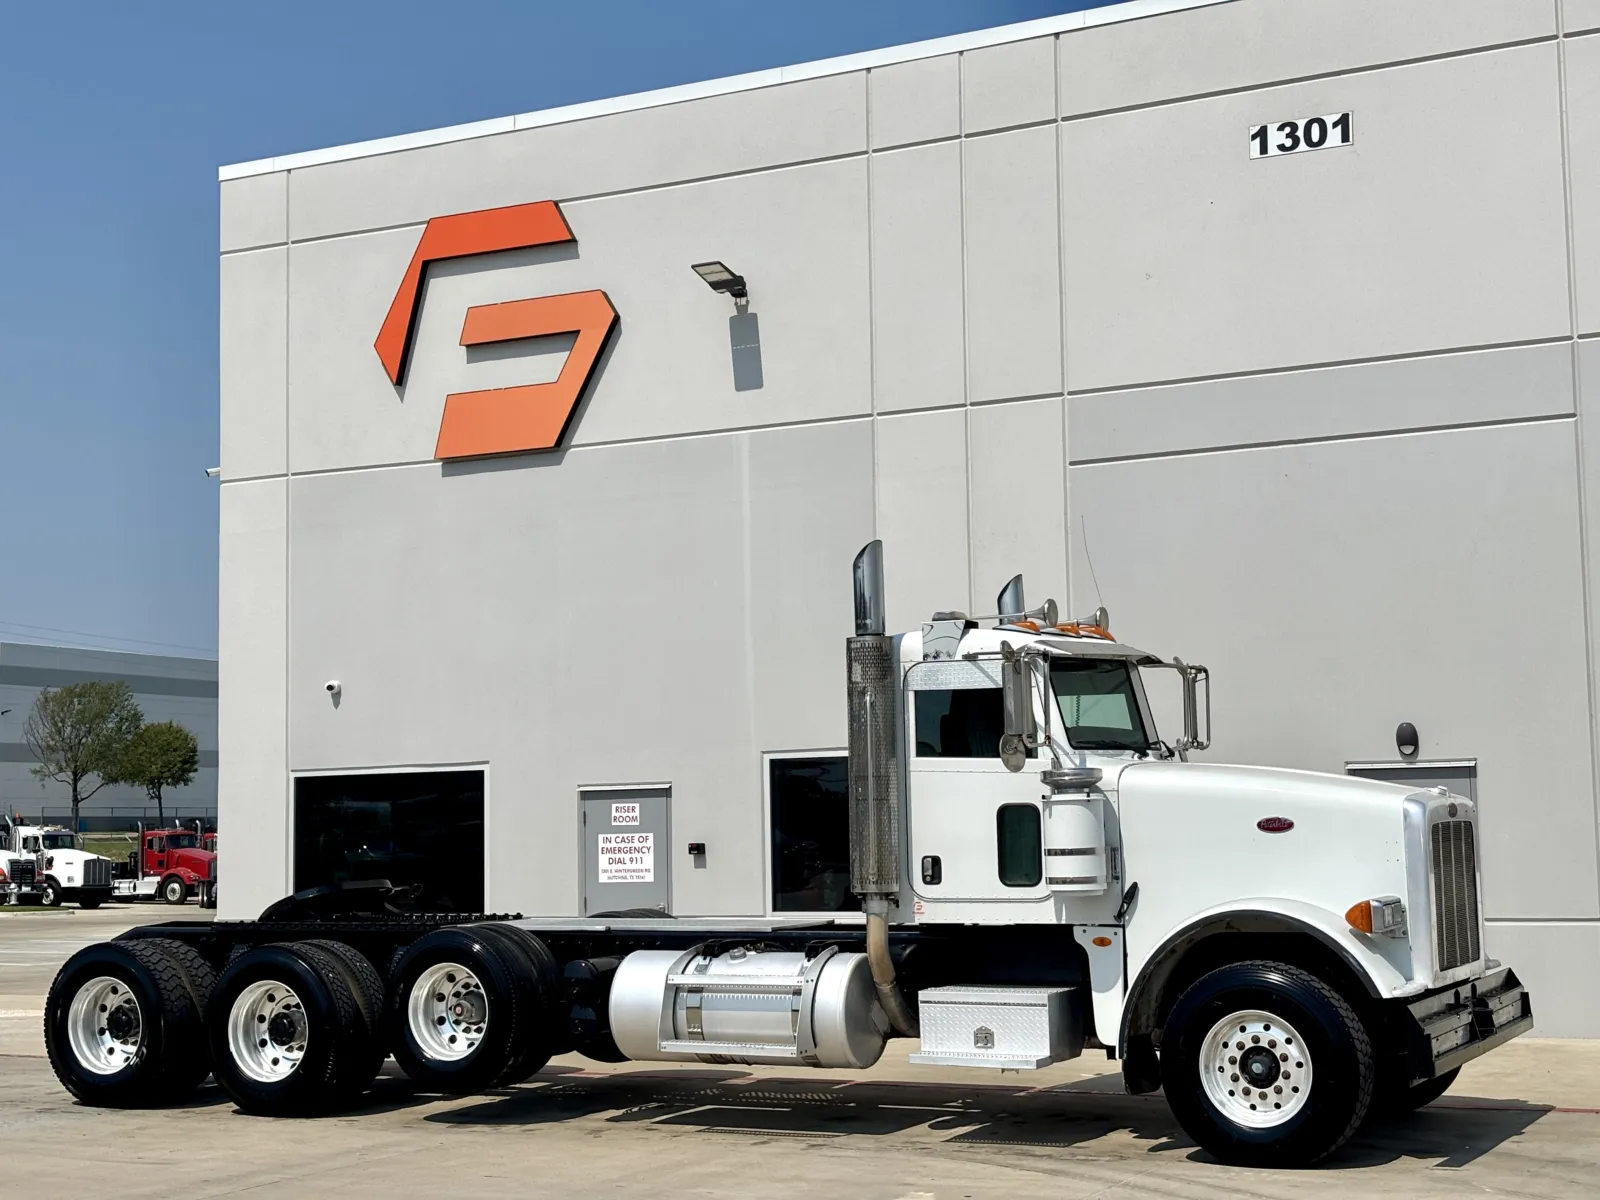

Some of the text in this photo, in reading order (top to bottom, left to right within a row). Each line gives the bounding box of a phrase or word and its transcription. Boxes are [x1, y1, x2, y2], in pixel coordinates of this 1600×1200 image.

[1250, 112, 1350, 156] 1301
[613, 815, 638, 823] ROOM
[602, 835, 650, 844] IN CASE OF
[601, 846, 651, 854] EMERGENCY
[608, 857, 627, 865] DIAL
